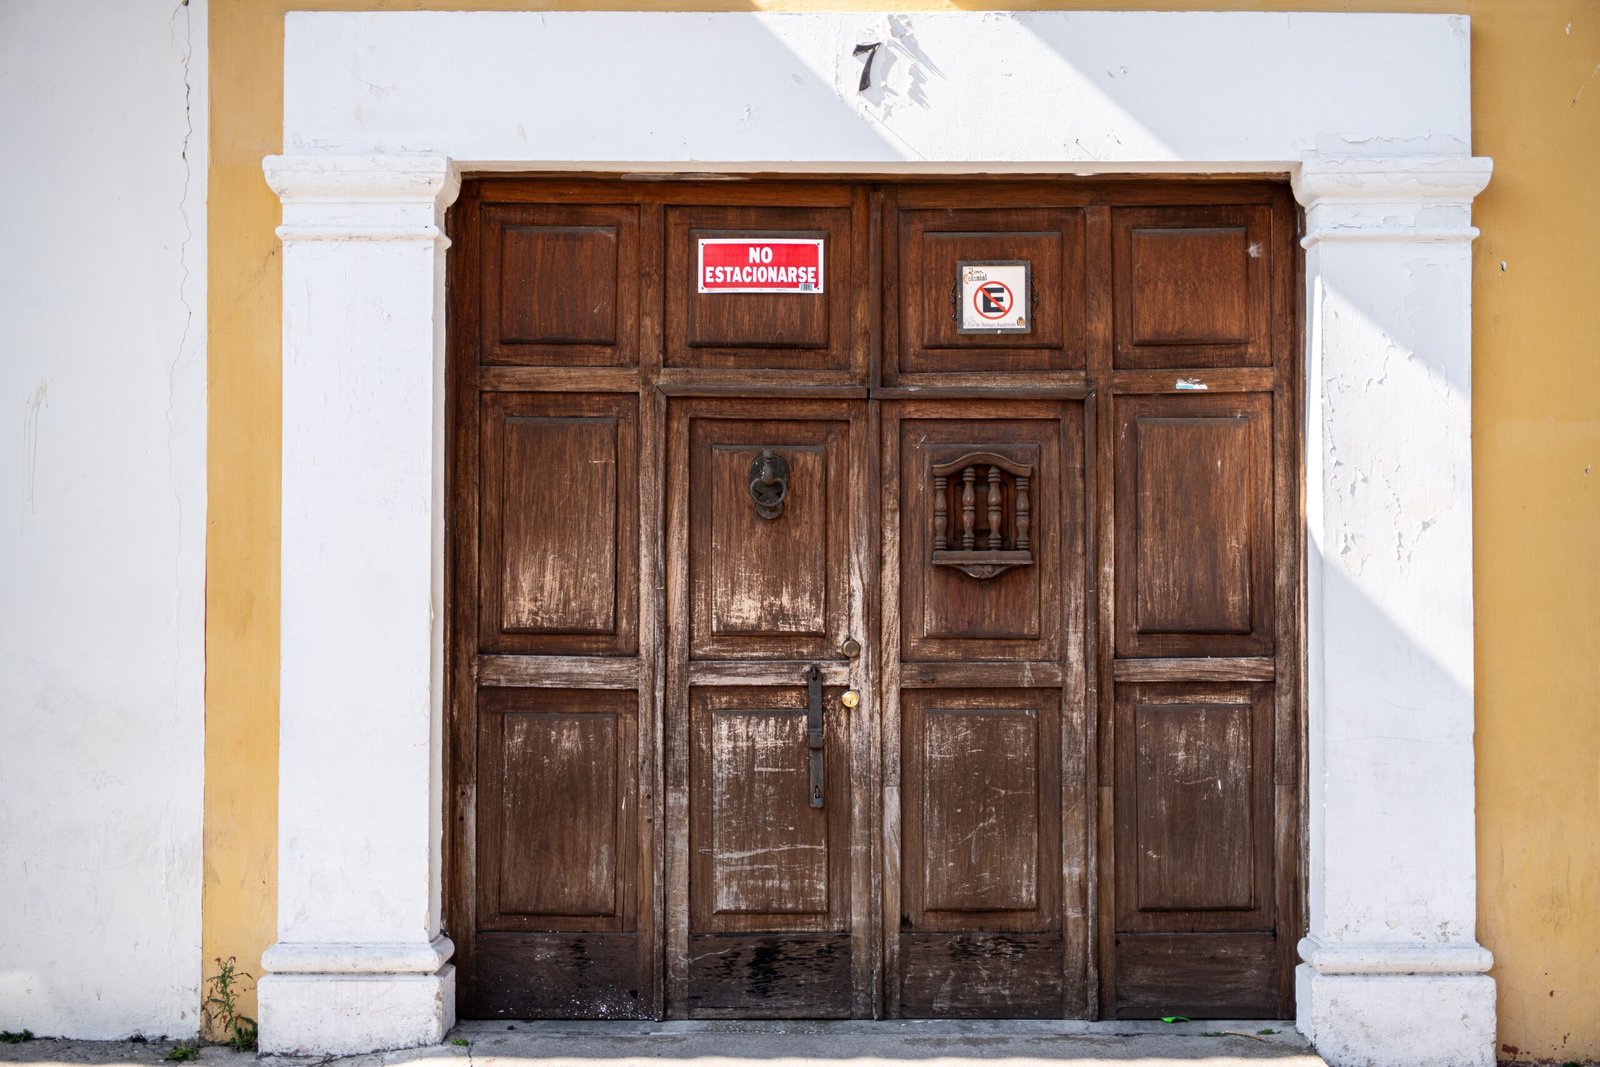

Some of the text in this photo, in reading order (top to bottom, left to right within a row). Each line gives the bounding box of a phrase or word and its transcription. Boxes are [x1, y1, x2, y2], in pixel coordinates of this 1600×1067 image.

[852, 42, 881, 92] 7
[748, 246, 773, 264] NO
[705, 266, 817, 283] ESTACIONARSE
